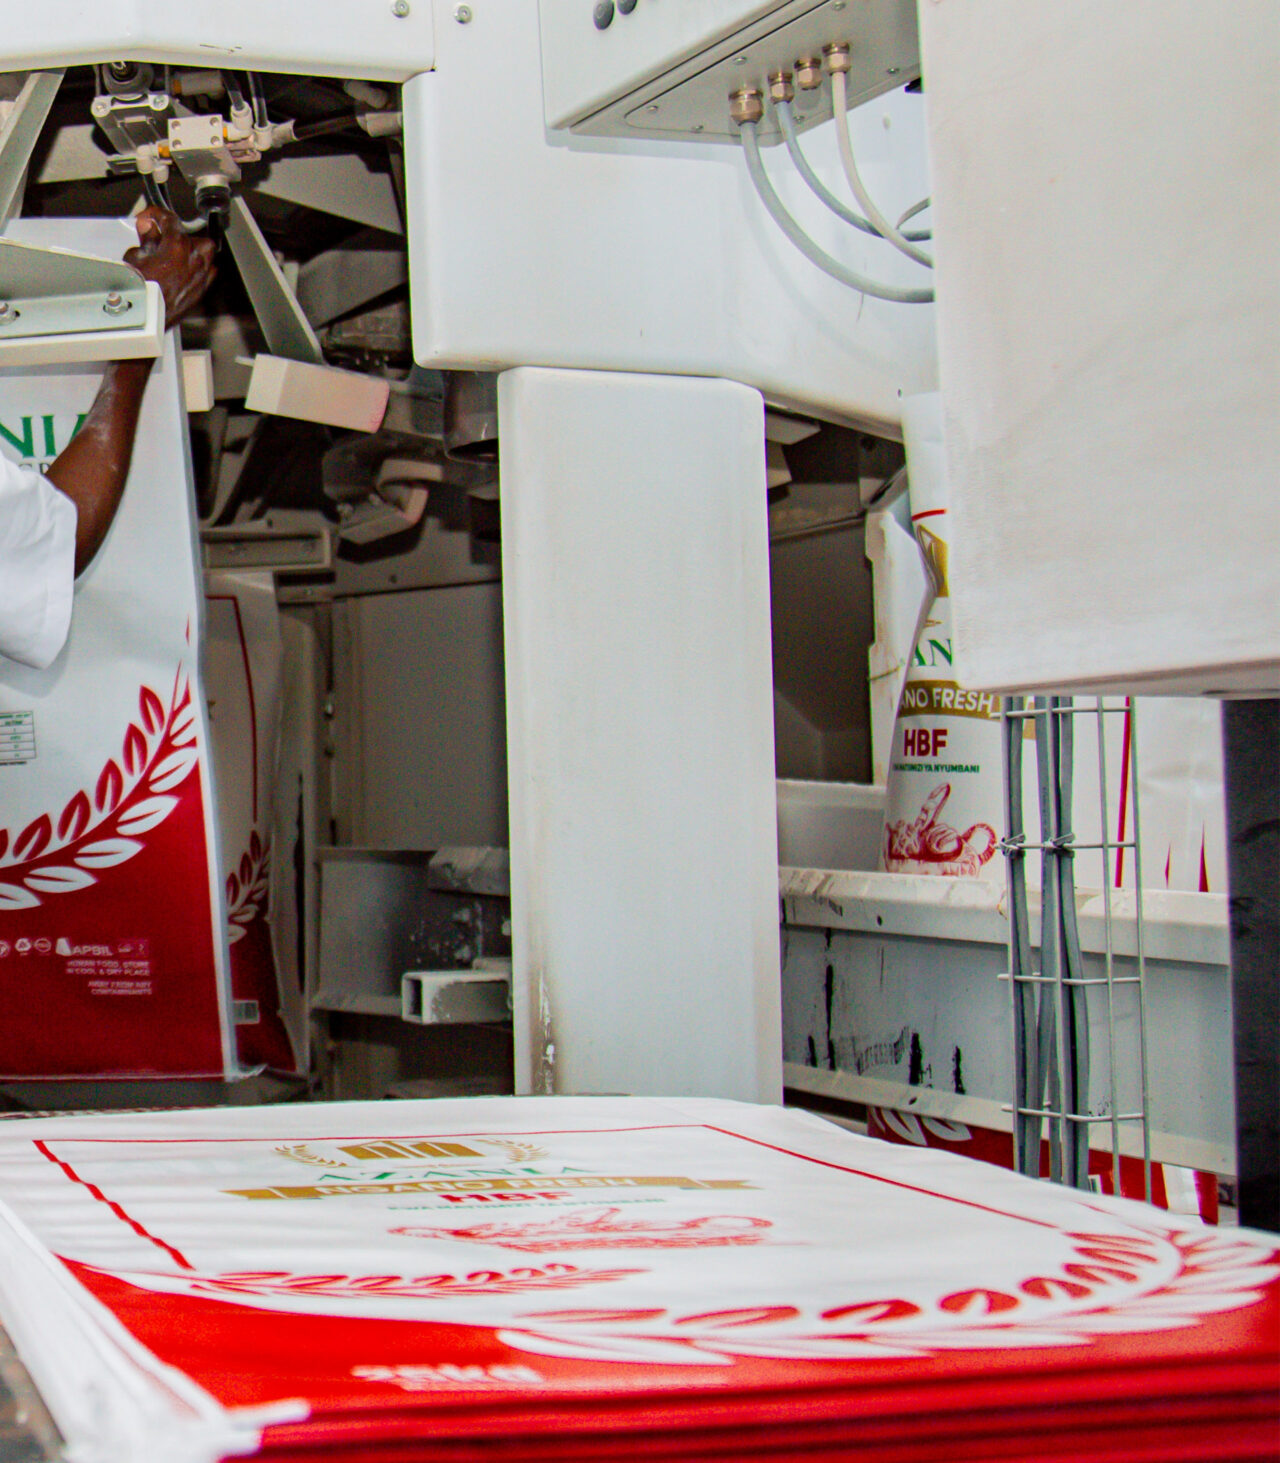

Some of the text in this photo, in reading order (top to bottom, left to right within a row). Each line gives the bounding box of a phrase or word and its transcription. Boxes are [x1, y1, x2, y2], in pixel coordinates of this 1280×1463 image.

[932, 687, 994, 713] FRESH
[903, 728, 949, 757] HBF
[934, 764, 980, 773] NYUMBANI
[318, 1166, 604, 1182] AZANIA
[314, 1177, 639, 1195] NGANO FRESH
[437, 1192, 575, 1204] HBF
